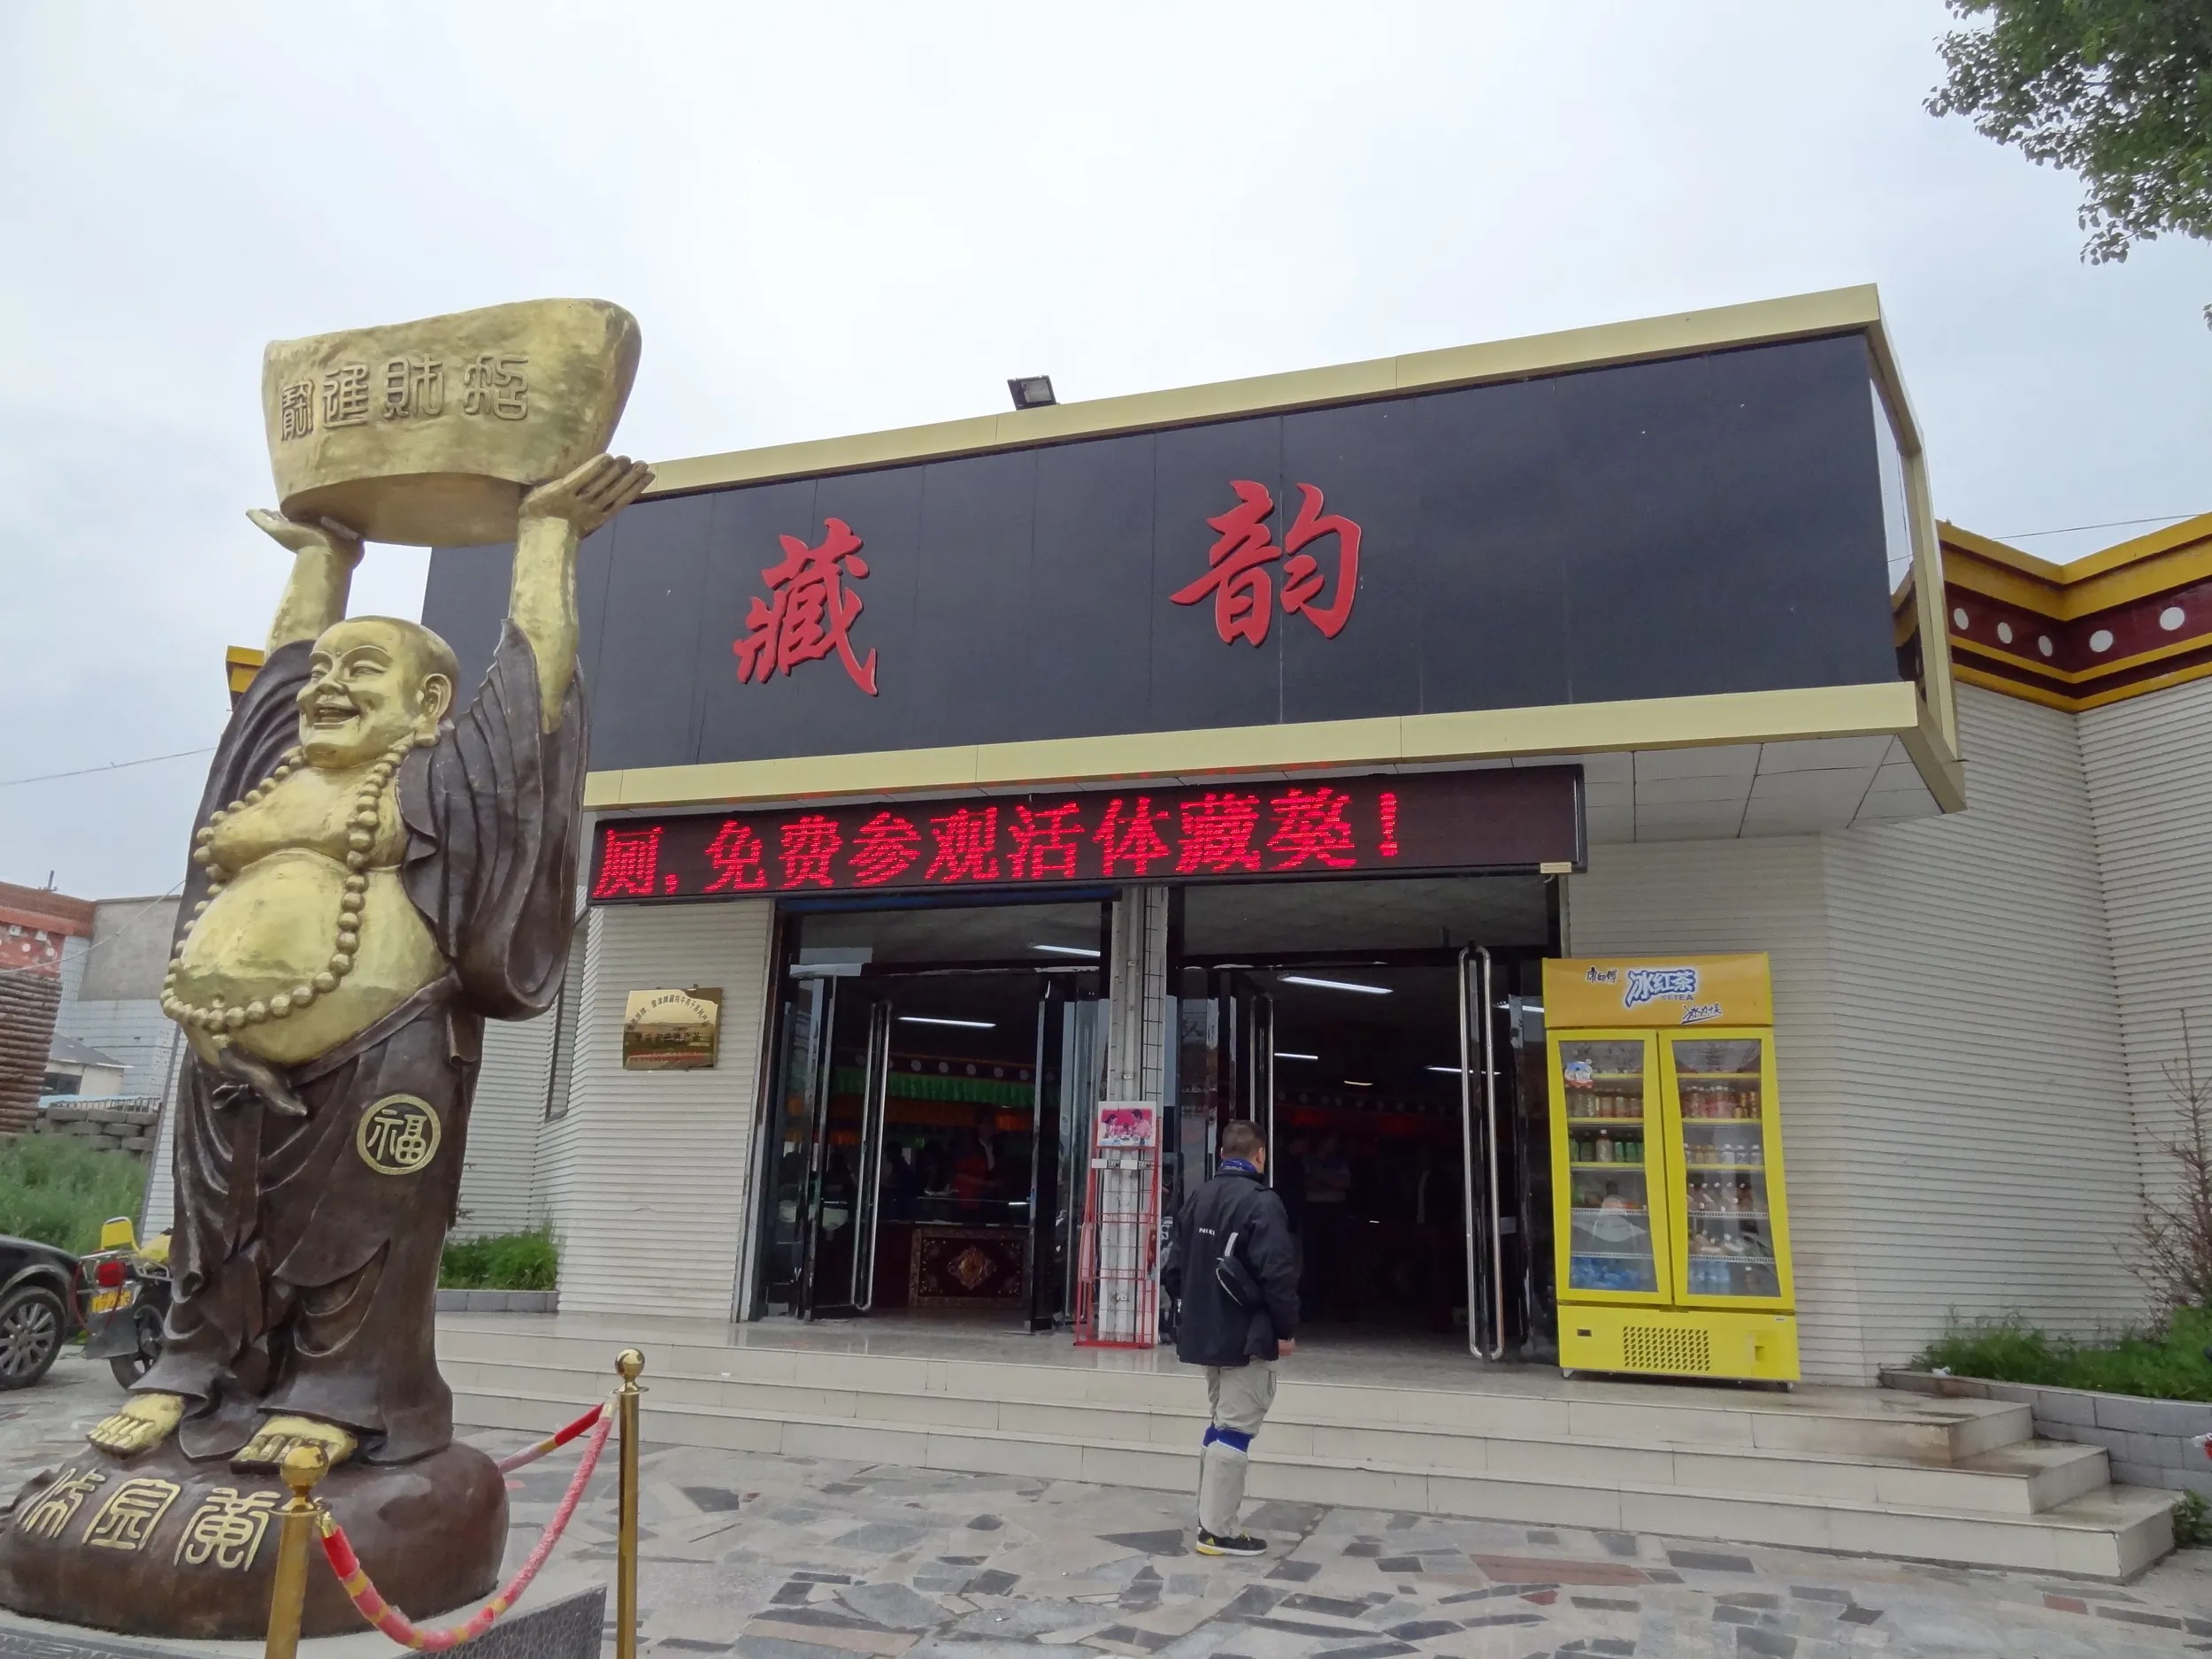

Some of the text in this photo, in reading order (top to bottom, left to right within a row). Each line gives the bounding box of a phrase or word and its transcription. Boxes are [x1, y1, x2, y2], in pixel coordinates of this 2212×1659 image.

[1625, 969, 1696, 1008] 冰红茶
[366, 1109, 428, 1164] 福
